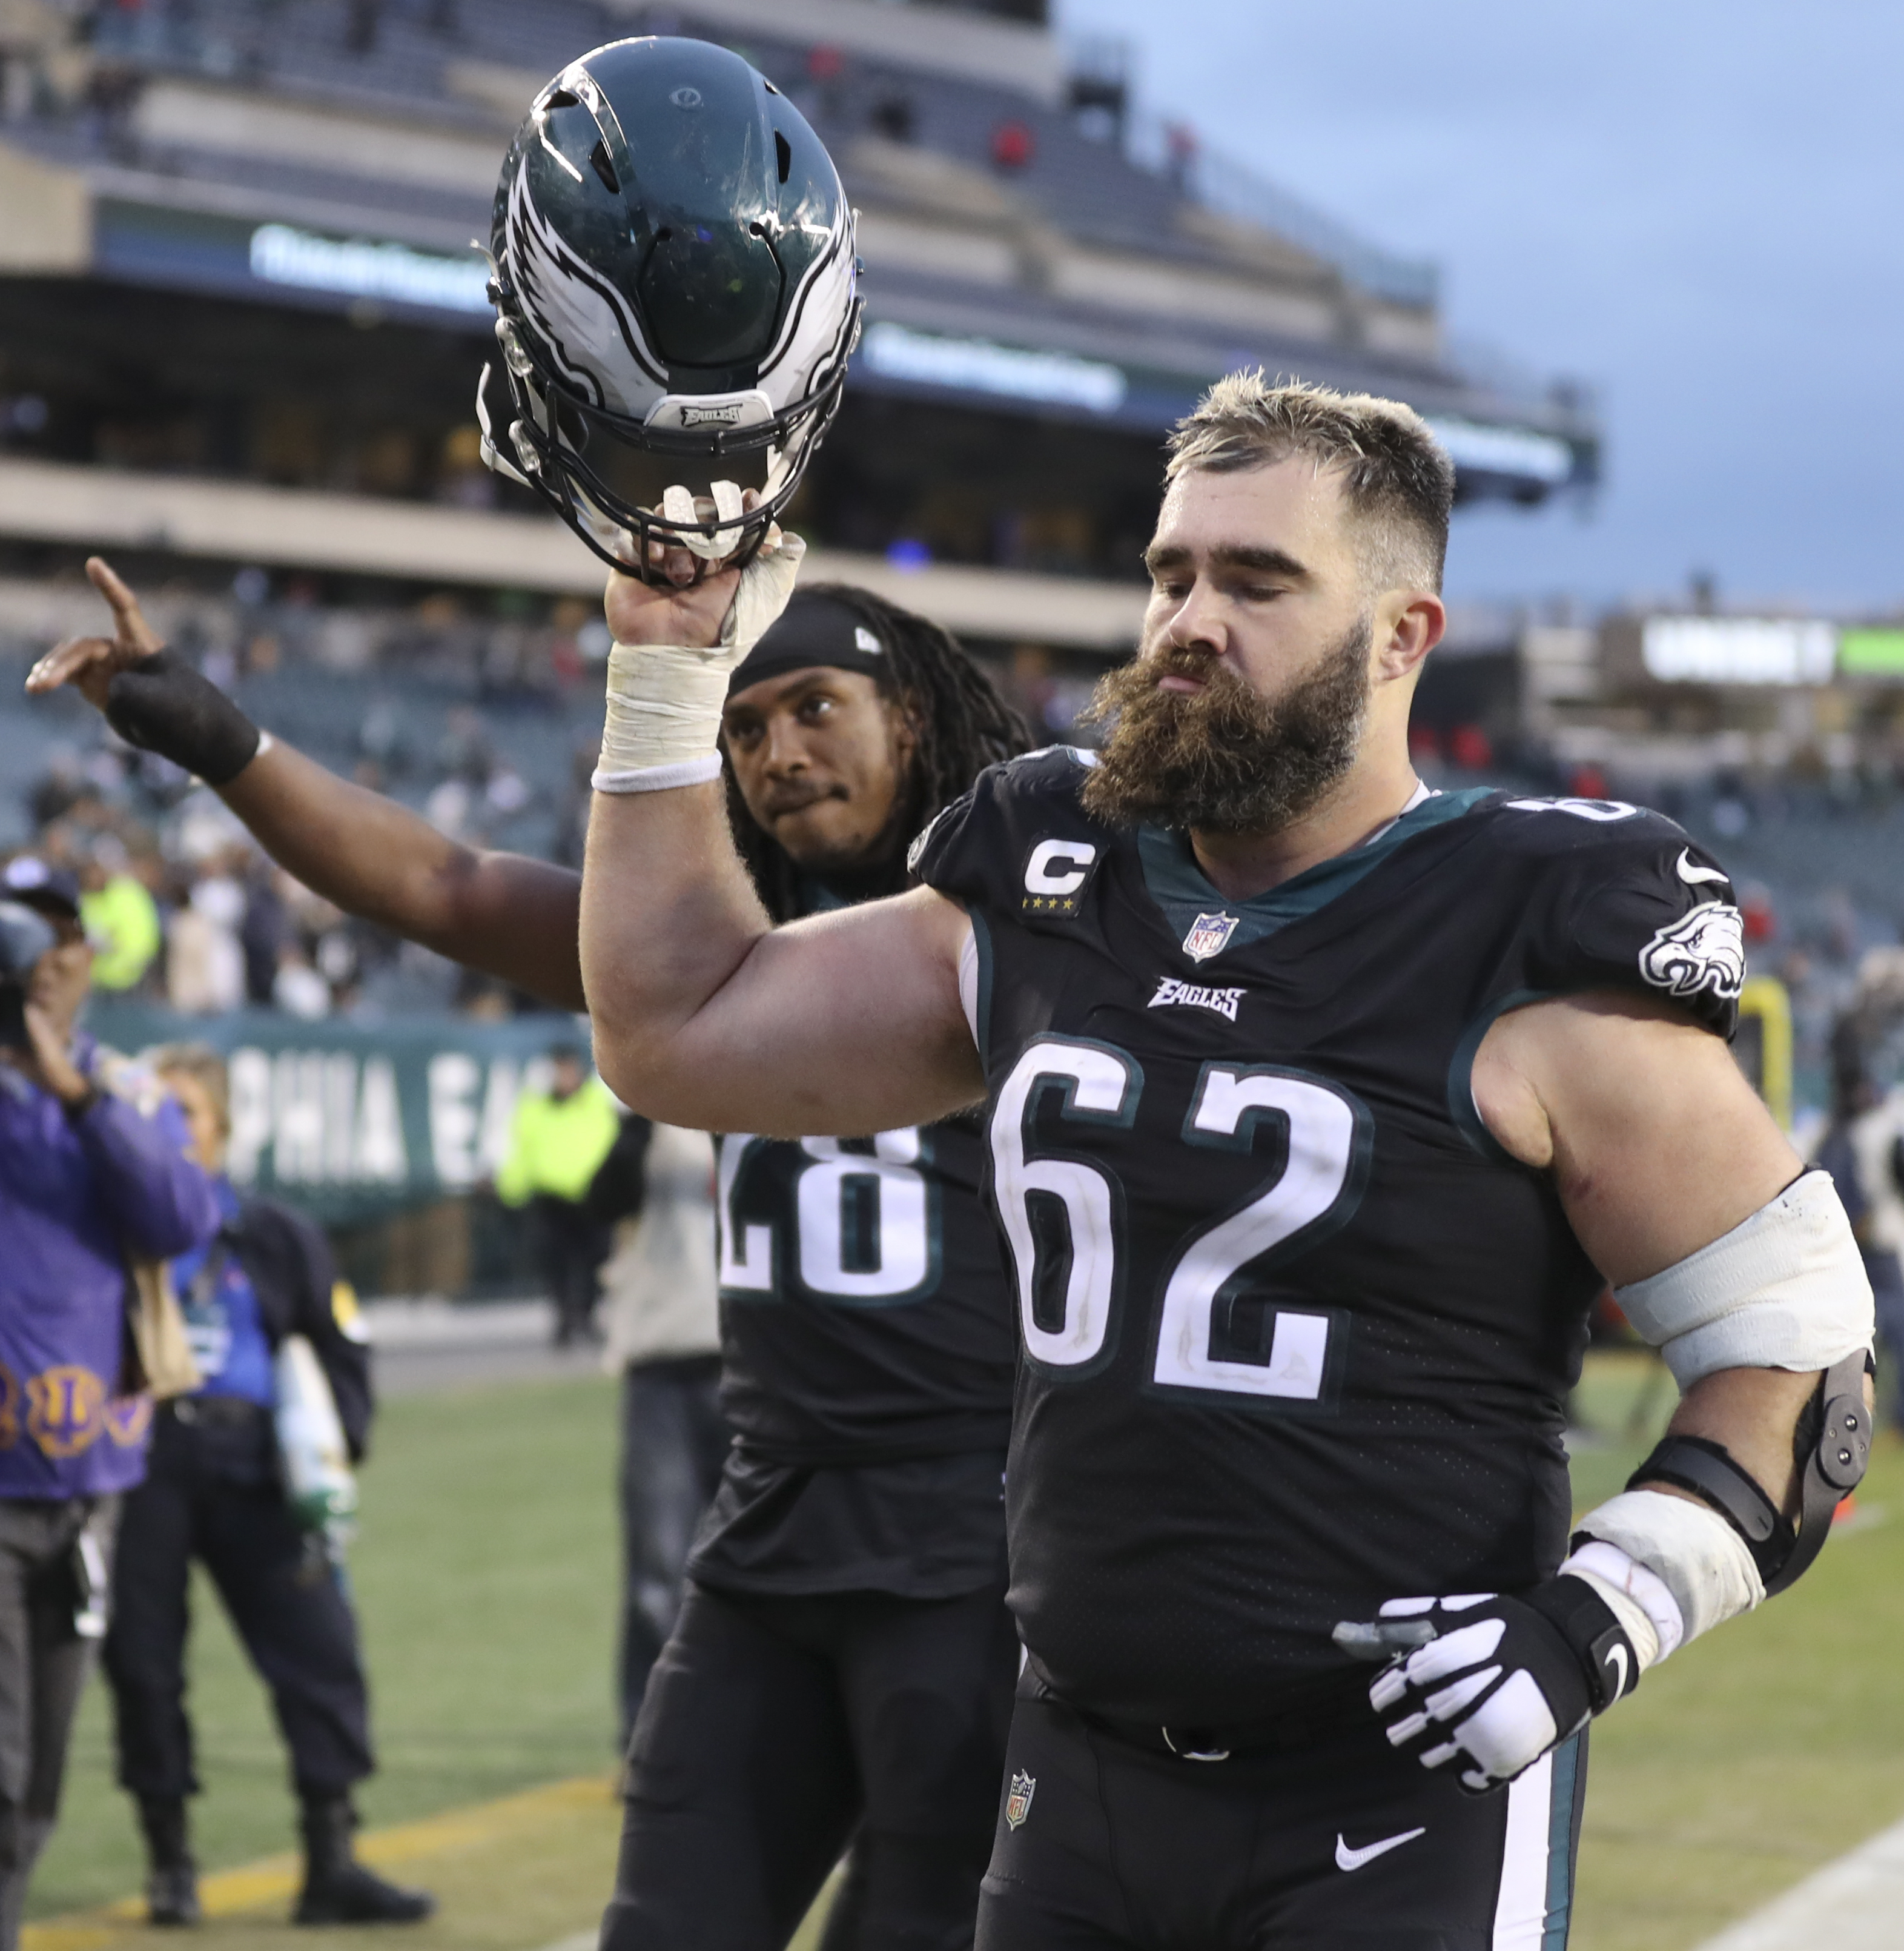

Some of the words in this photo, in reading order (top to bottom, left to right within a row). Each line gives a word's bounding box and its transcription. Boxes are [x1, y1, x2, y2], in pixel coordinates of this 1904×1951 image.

[681, 403, 743, 426] EAGLES
[1024, 838, 1096, 895] C
[1191, 931, 1222, 951] NFL
[1147, 976, 1248, 1022] EAGLES
[426, 1053, 554, 1186] EA
[991, 1042, 1354, 1400] 62
